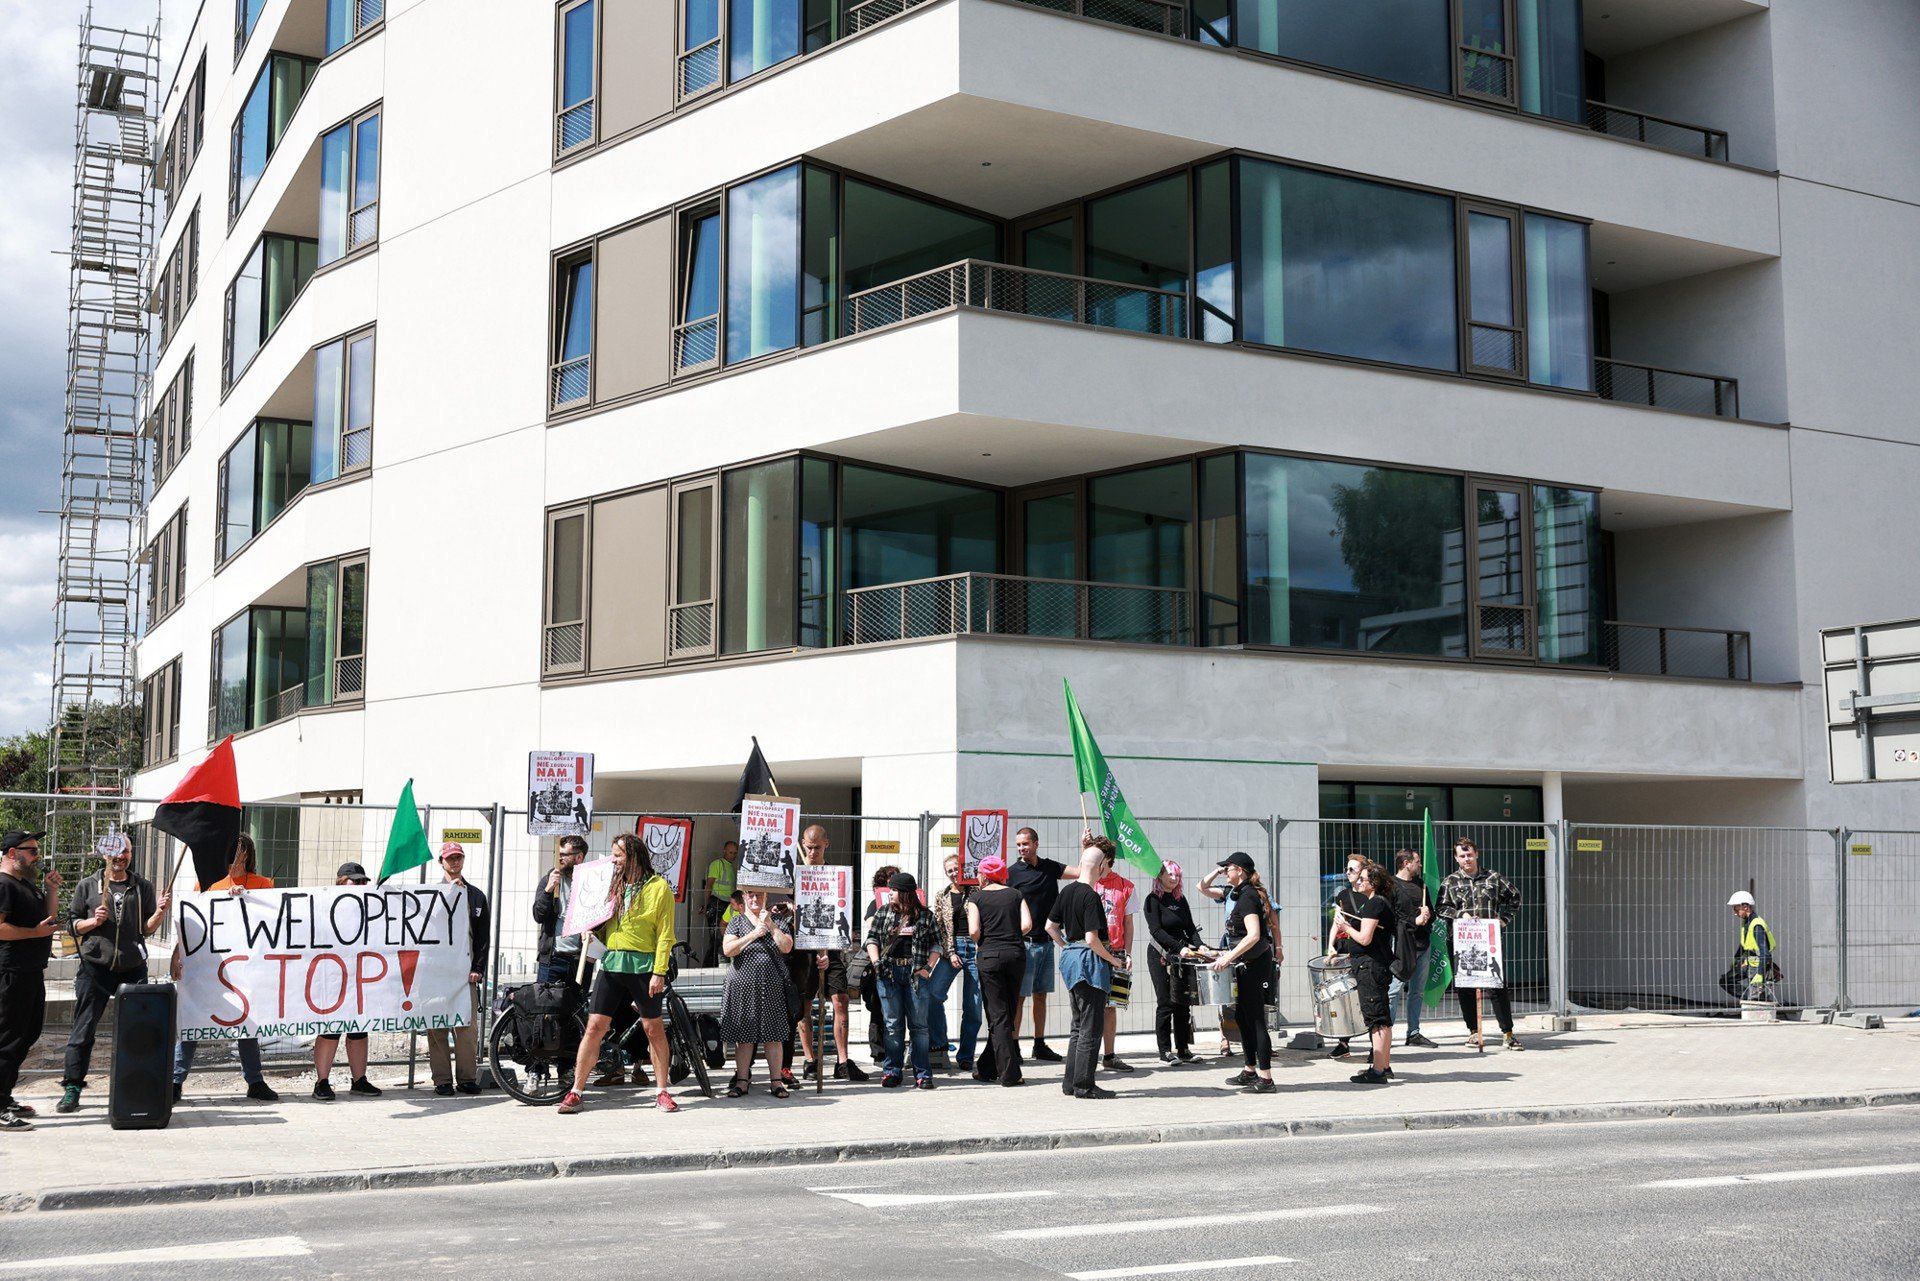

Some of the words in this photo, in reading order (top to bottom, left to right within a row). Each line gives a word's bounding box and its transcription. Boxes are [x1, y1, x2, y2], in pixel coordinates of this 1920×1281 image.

[536, 768, 568, 777] NAM
[747, 817, 778, 828] NAM
[1117, 834, 1142, 855] DOM
[801, 882, 830, 891] NAM
[179, 889, 463, 957] DEWELOPERZY
[1458, 931, 1483, 940] NAM
[210, 949, 421, 1027] STOP!
[180, 1025, 250, 1041] FEDERACJA
[431, 1013, 465, 1029] FALA
